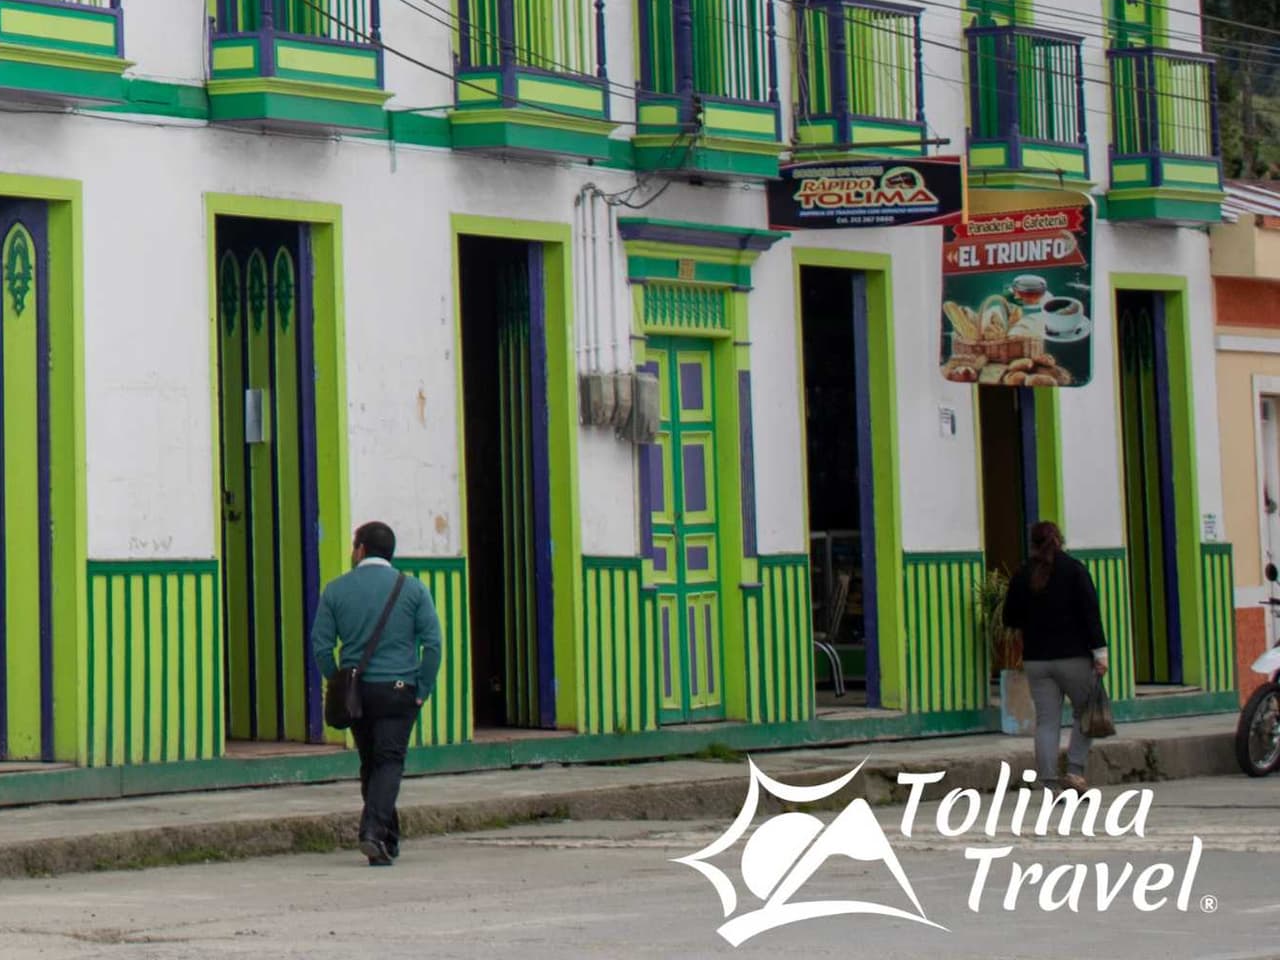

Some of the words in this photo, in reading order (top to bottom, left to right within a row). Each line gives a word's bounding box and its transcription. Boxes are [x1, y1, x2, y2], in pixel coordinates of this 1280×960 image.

[802, 178, 873, 192] RÁPIDO
[798, 190, 938, 208] TOLIMA
[958, 245, 980, 267] EL
[985, 238, 1067, 265] TRIUNFO
